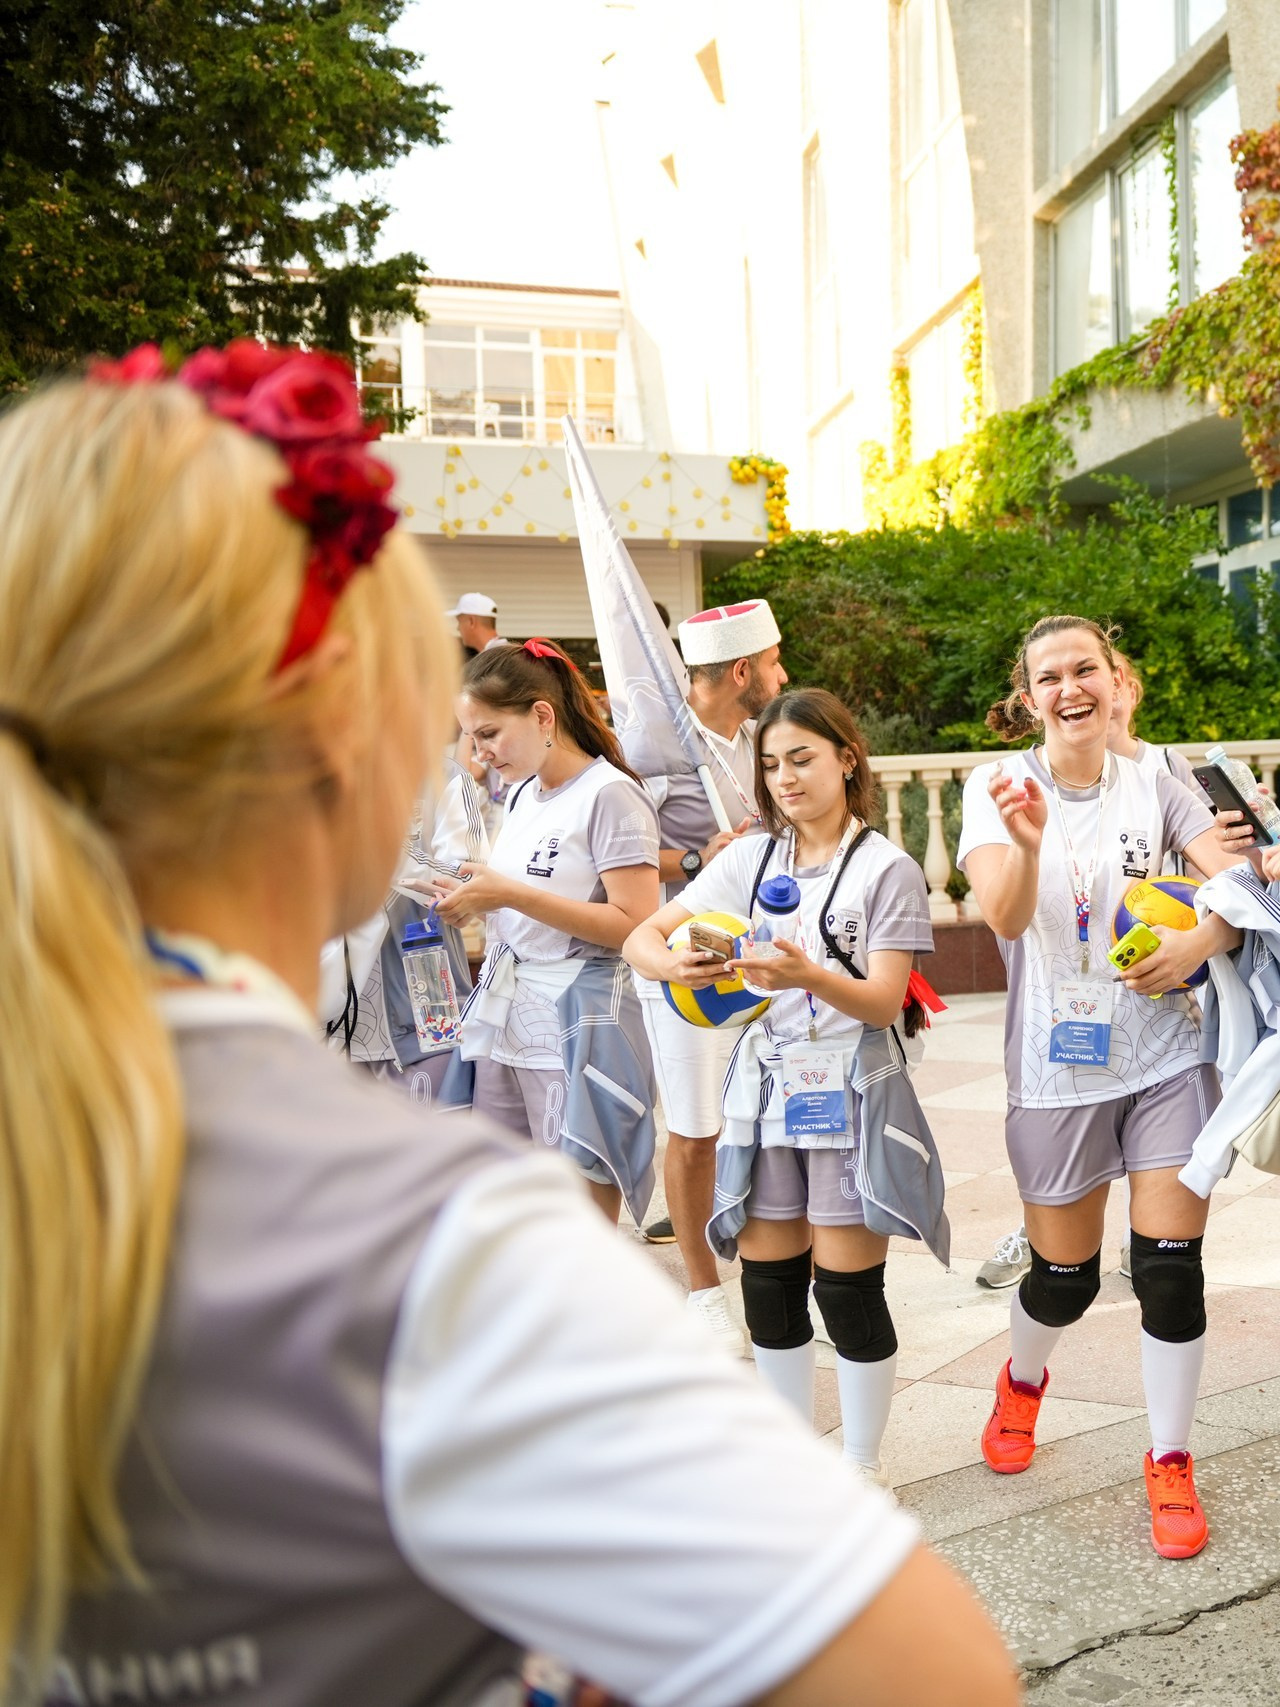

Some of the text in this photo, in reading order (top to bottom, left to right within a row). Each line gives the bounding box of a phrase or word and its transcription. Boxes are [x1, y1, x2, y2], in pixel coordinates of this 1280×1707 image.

[1126, 870, 1145, 878] МАГНИТ
[1056, 1052, 1094, 1061] УЧАСТНИК
[543, 1081, 564, 1146] 8
[792, 1122, 831, 1131] УЧАСТНИК
[1166, 1240, 1190, 1249] asics
[1057, 1265, 1080, 1273] asics
[20, 1636, 261, 1706] АНИЯ
